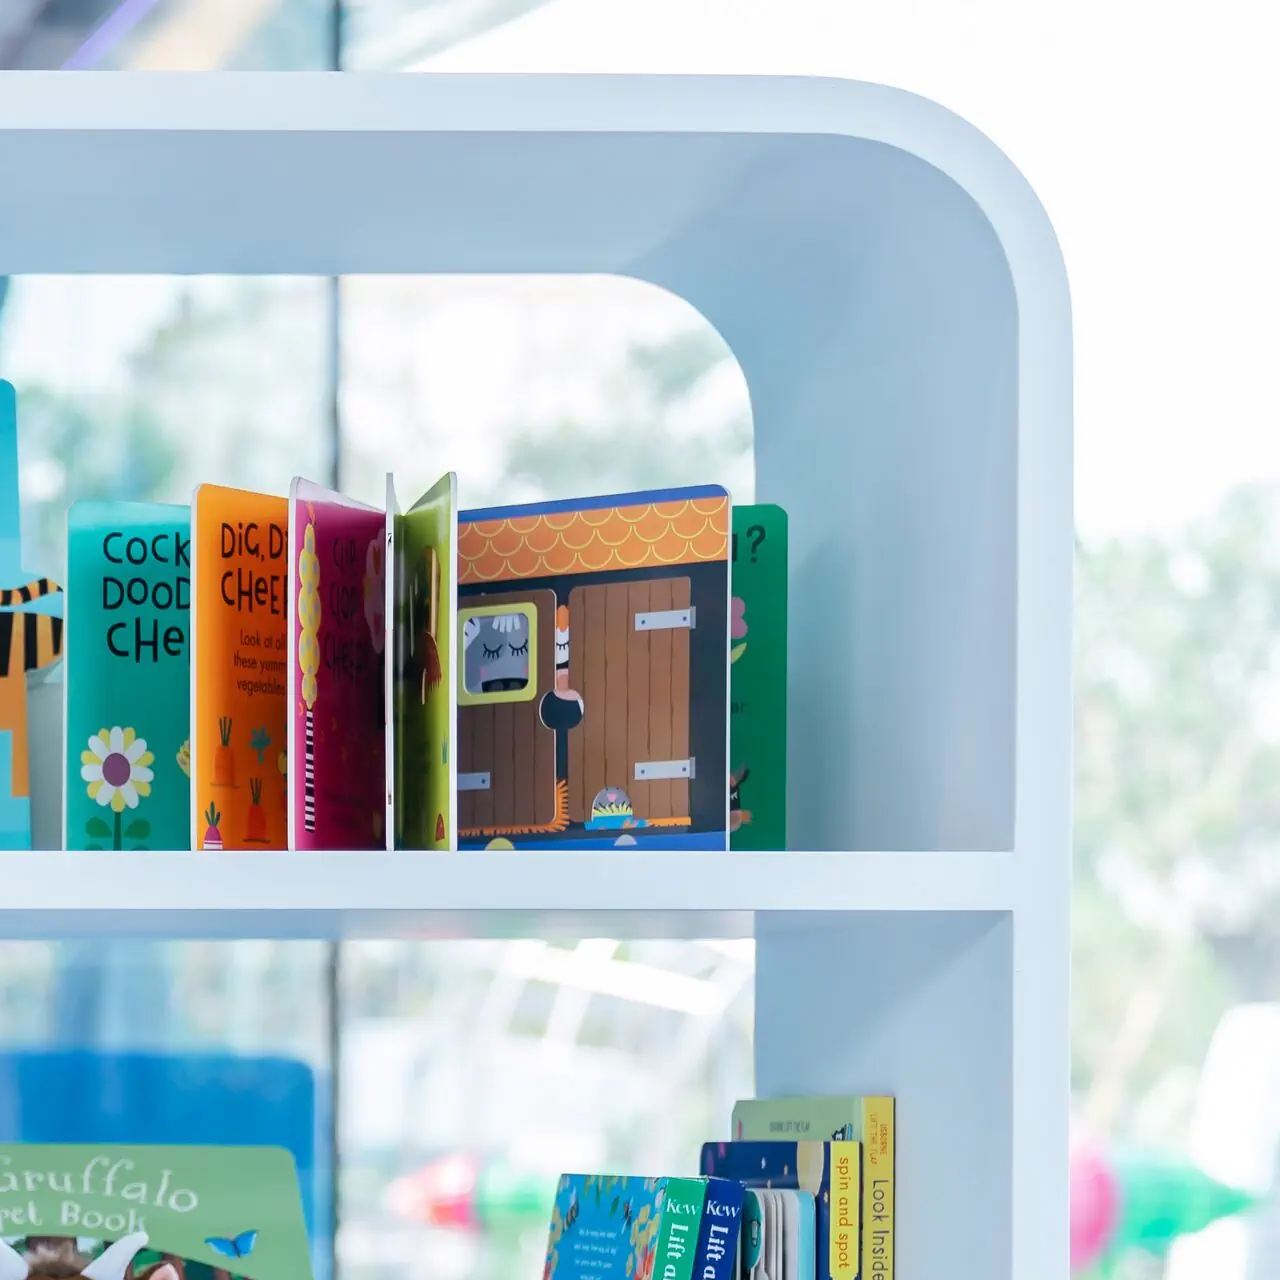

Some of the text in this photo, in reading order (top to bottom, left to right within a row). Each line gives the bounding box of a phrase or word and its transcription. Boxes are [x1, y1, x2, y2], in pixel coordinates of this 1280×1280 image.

[240, 631, 261, 647] Look
[59, 1201, 147, 1233] Book
[666, 1197, 699, 1215] Kew
[706, 1199, 740, 1218] Kew
[835, 1157, 853, 1269] spin and spot
[872, 1179, 889, 1222] Look
[666, 1222, 689, 1260] Lift
[706, 1223, 729, 1262] Lift
